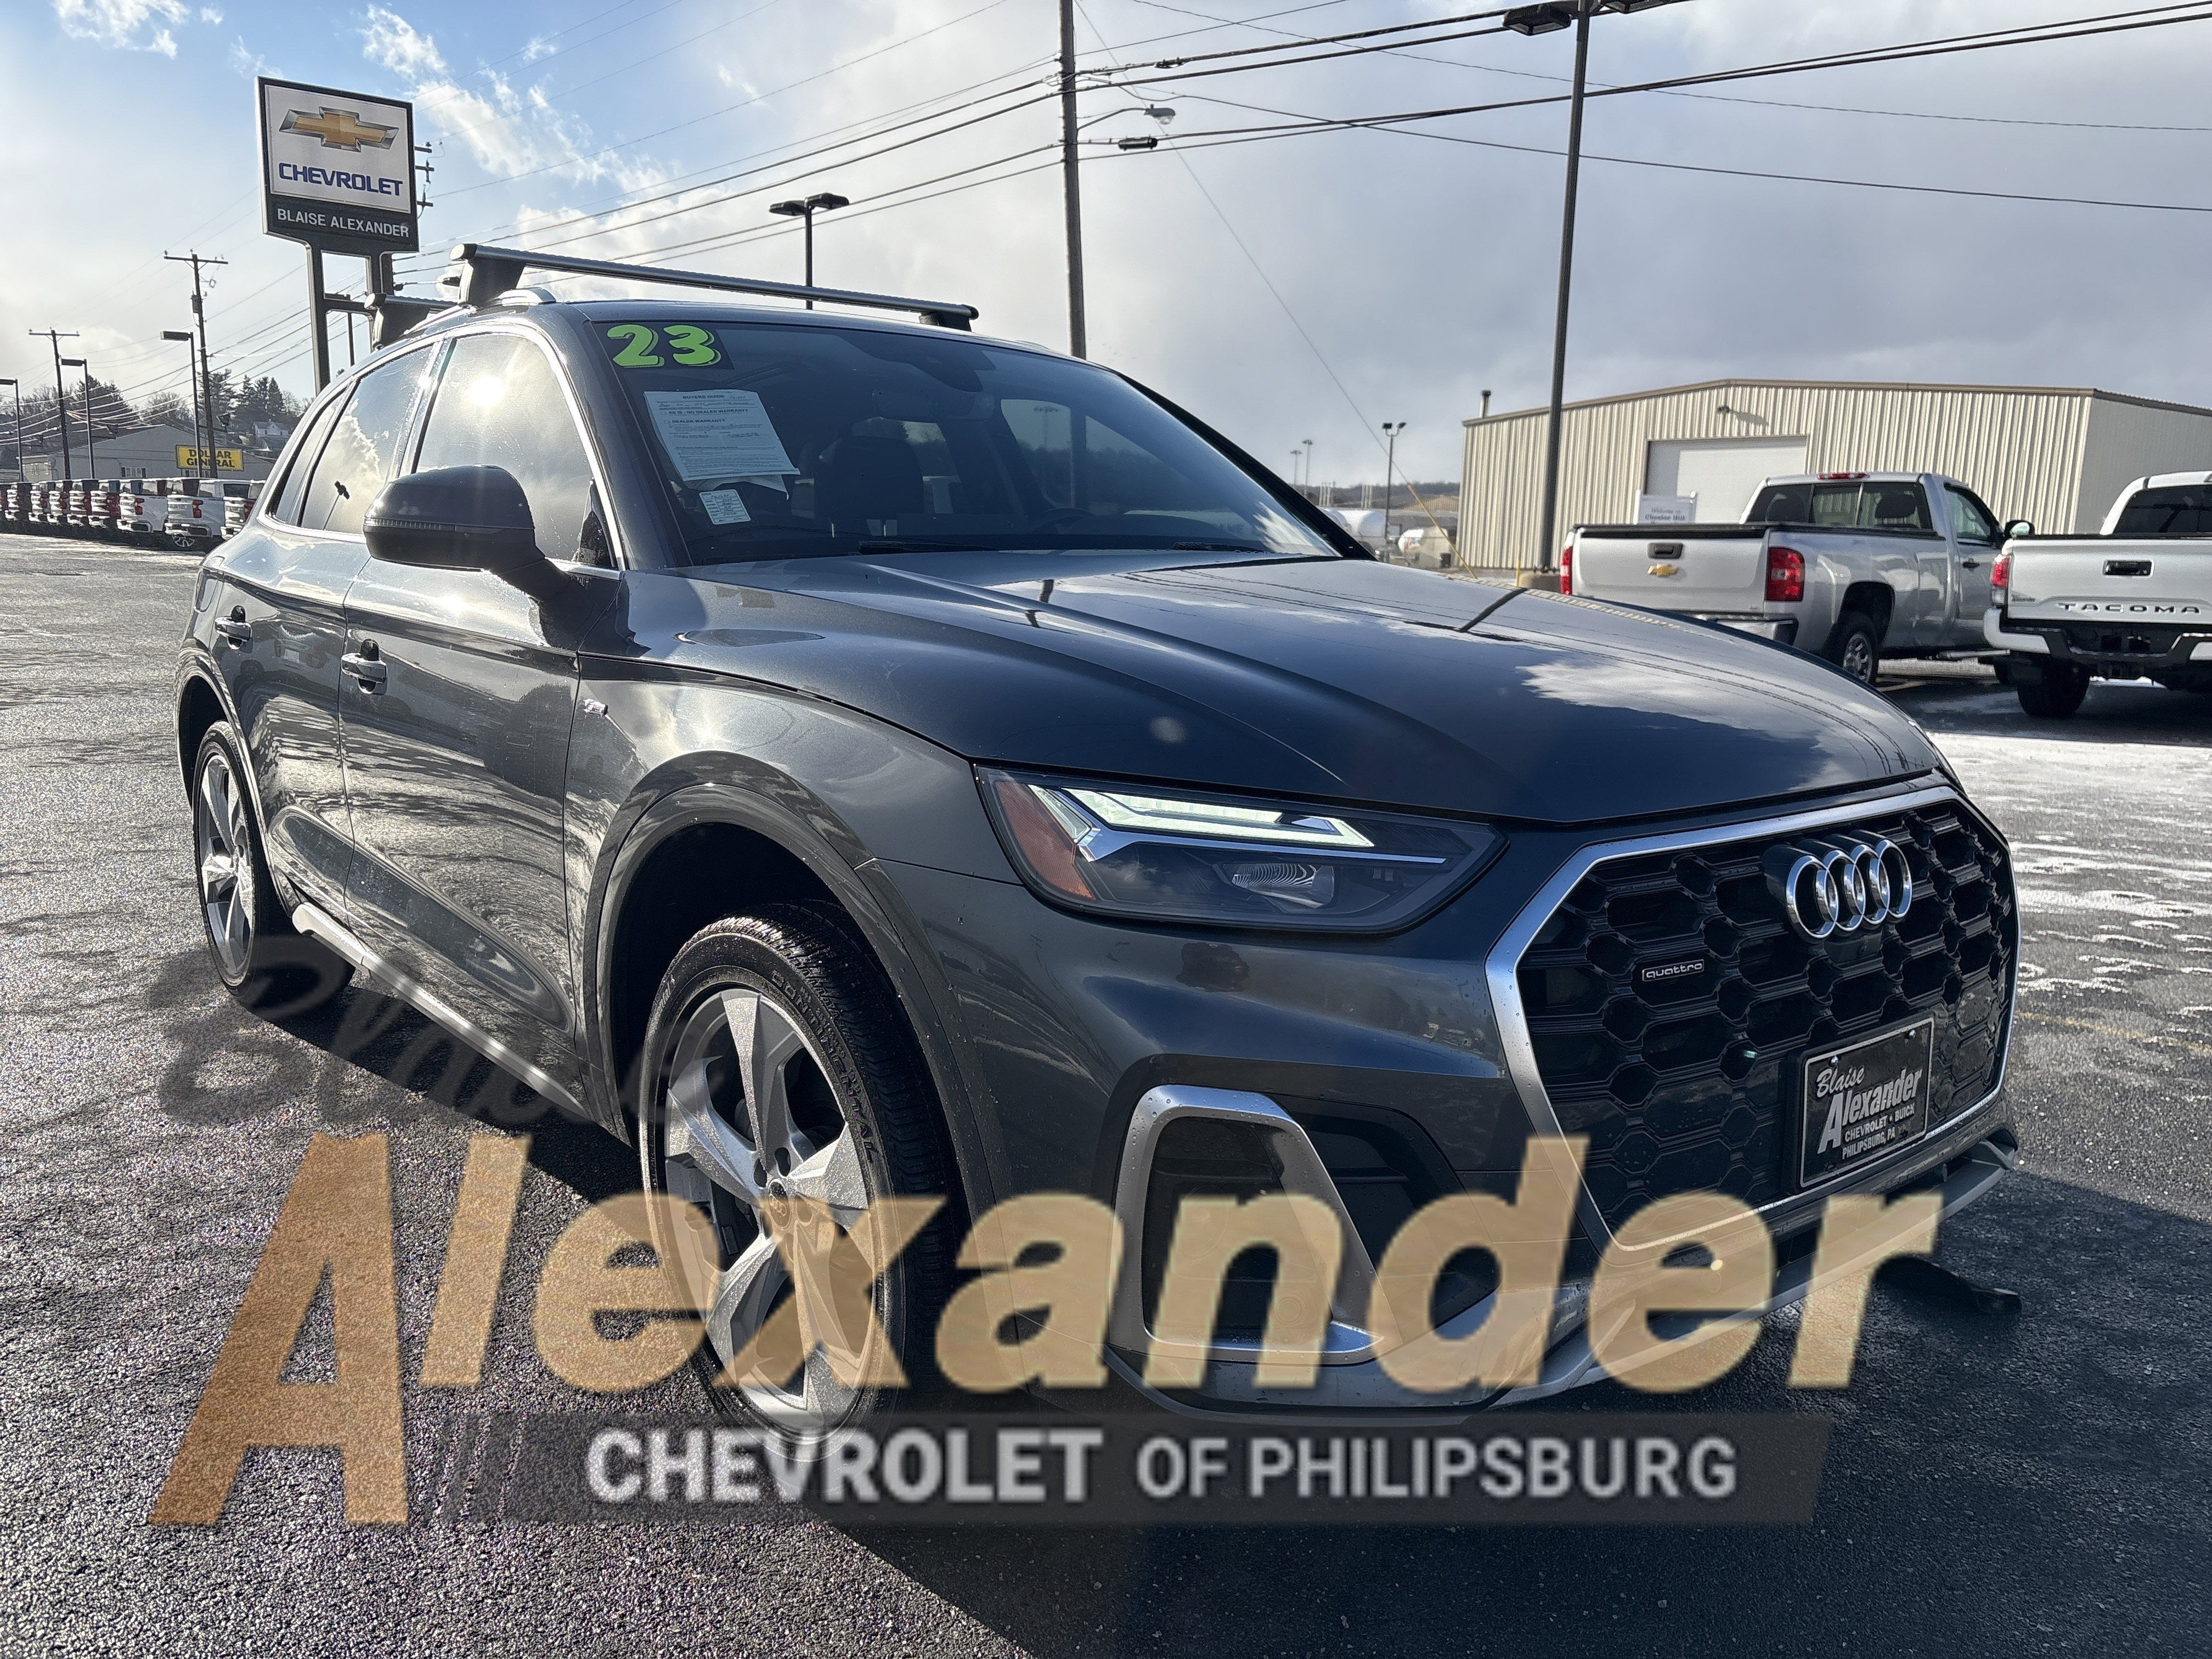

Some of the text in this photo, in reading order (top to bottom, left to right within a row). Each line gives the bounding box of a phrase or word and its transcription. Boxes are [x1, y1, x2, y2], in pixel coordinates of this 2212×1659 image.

[279, 162, 403, 196] CHEVROLET
[277, 207, 409, 238] BLAISE ALEXANDER
[607, 324, 721, 368] 23
[187, 458, 235, 468] GNRAL
[189, 449, 232, 459] DOLAR
[2057, 602, 2201, 614] TACOMA
[1646, 963, 1702, 979] quattro
[1816, 1065, 1865, 1098] Blaise
[1817, 1068, 1922, 1154] Alexander
[1844, 1102, 1915, 1143] CHEVROLET BUICK
[1842, 1127, 1895, 1160] PHILIPSBURG, PA
